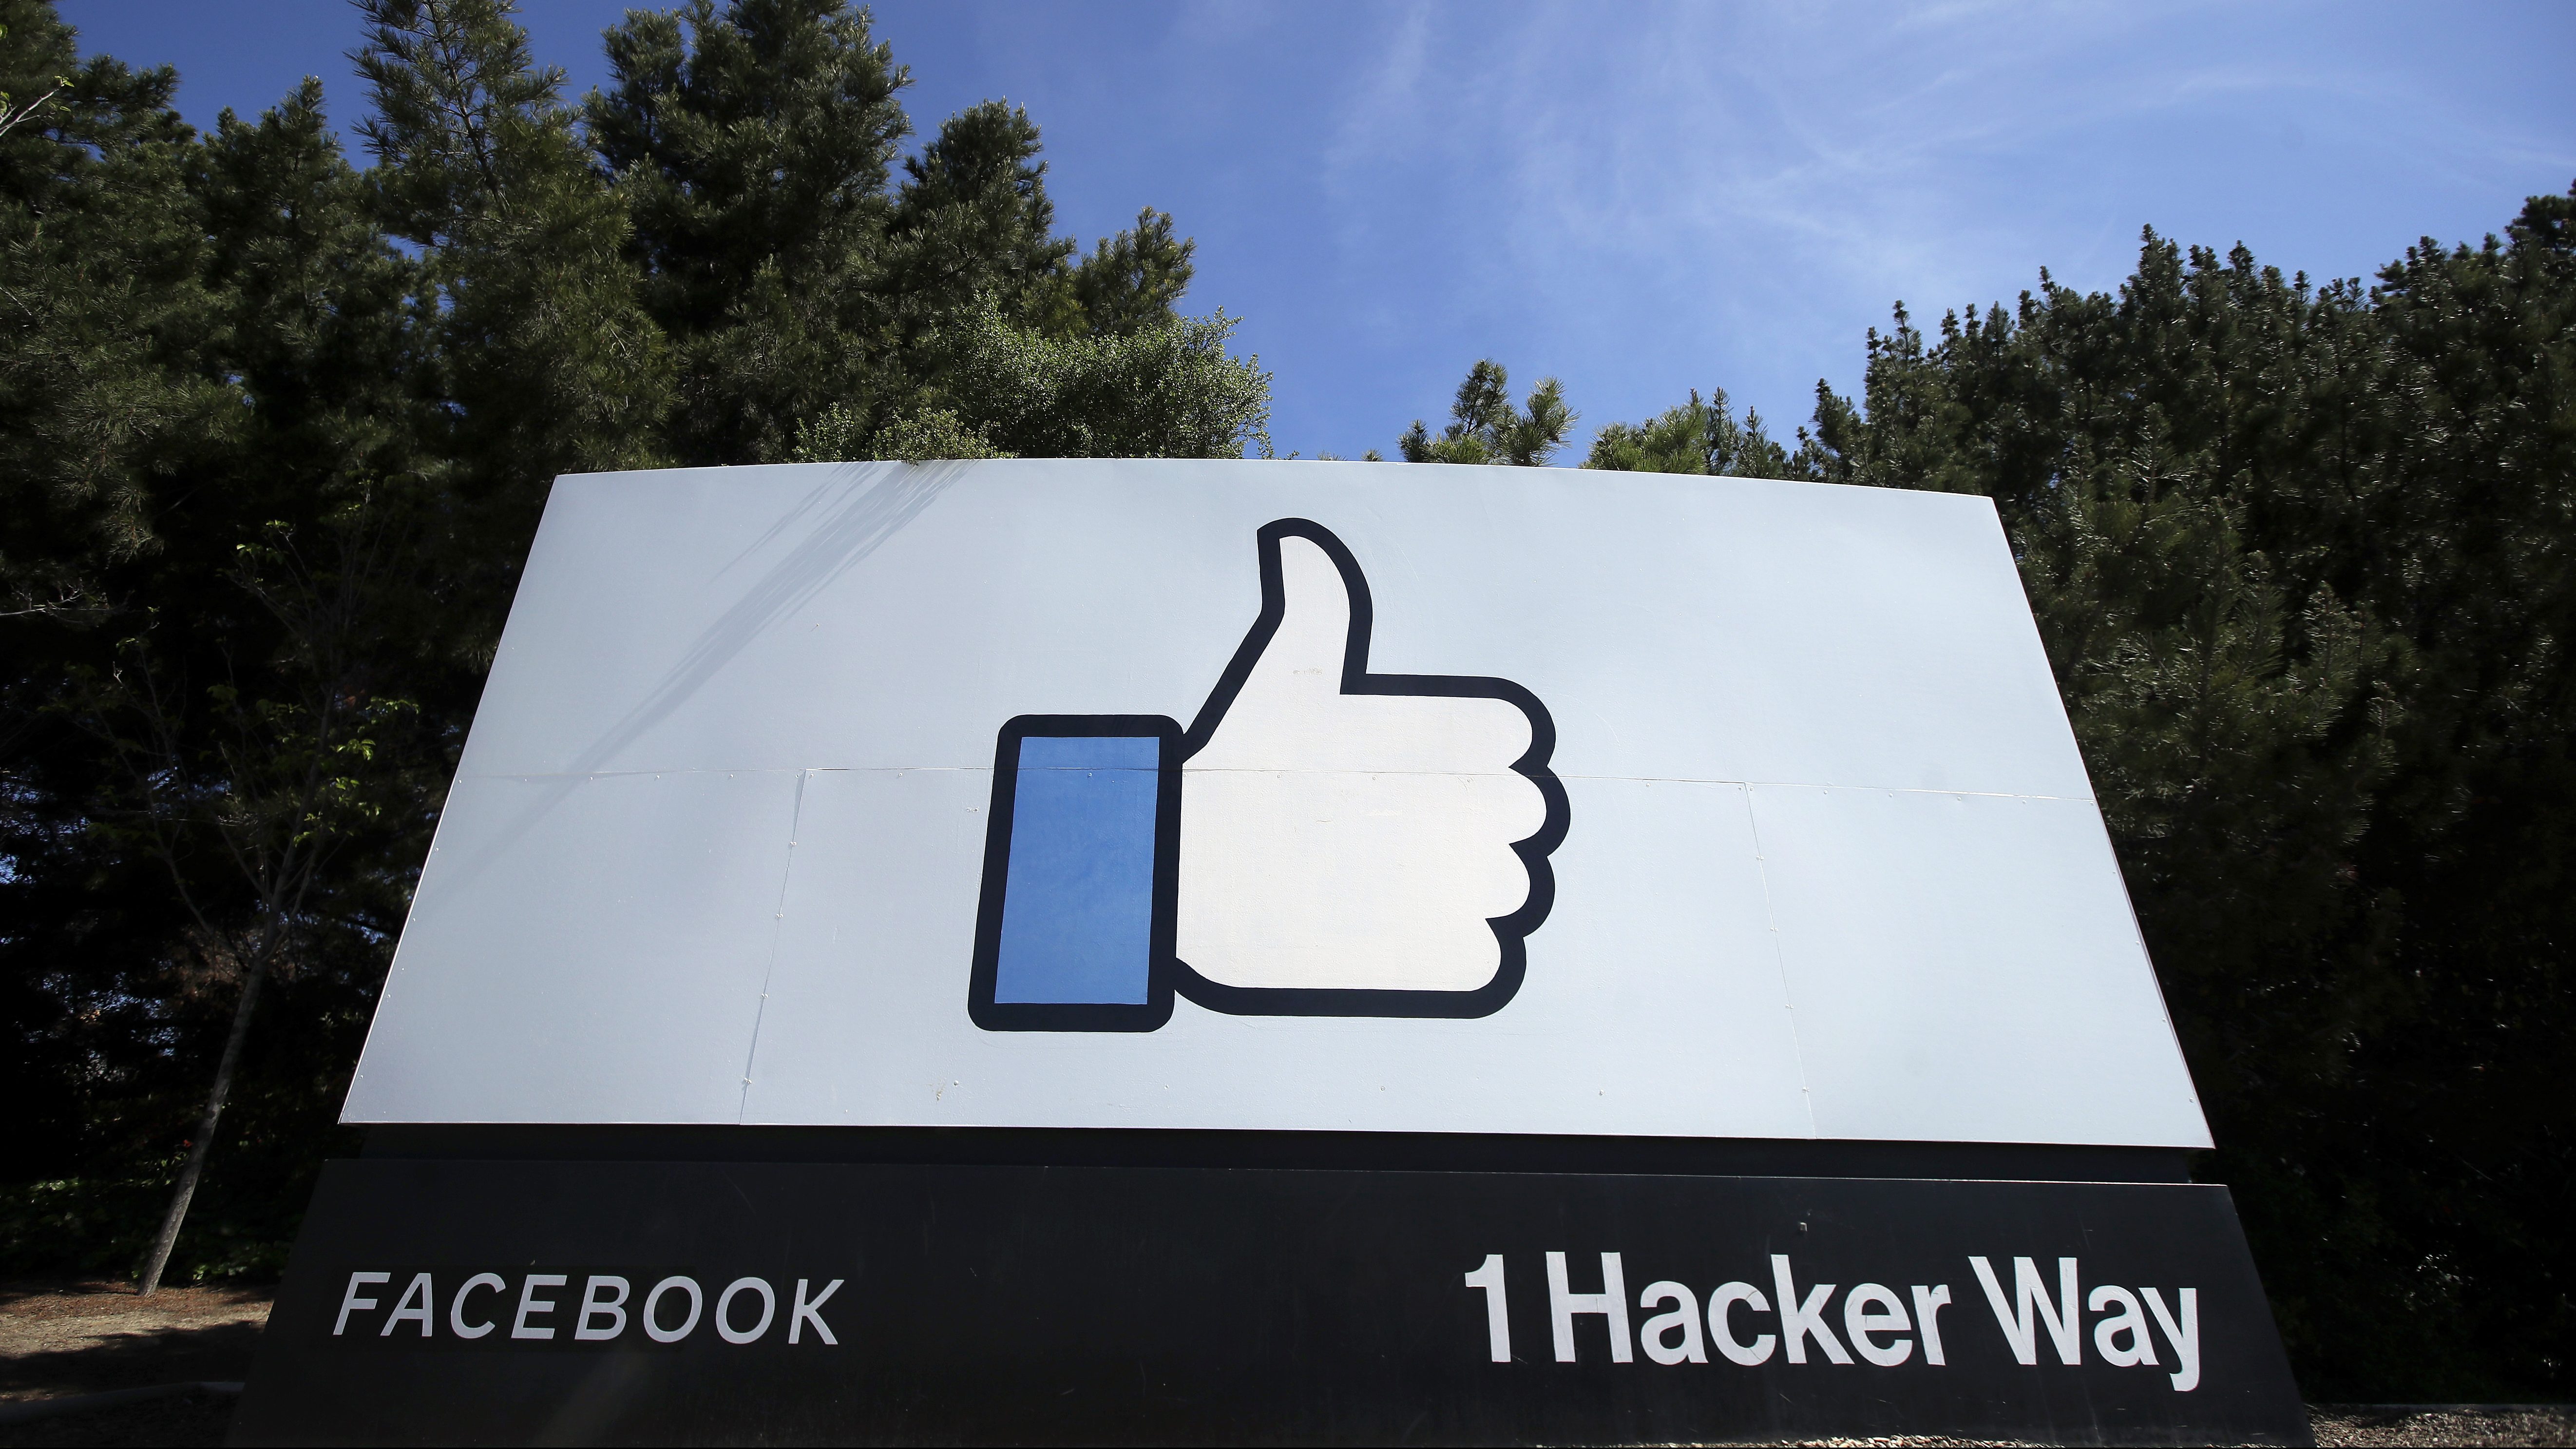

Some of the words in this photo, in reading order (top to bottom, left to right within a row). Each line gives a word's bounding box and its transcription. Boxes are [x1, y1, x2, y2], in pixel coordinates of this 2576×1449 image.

[333, 1272, 844, 1345] FACEBOOK
[1464, 1254, 1511, 1363] 1
[1546, 1251, 1951, 1367] Hacker
[1967, 1256, 2200, 1392] Way
